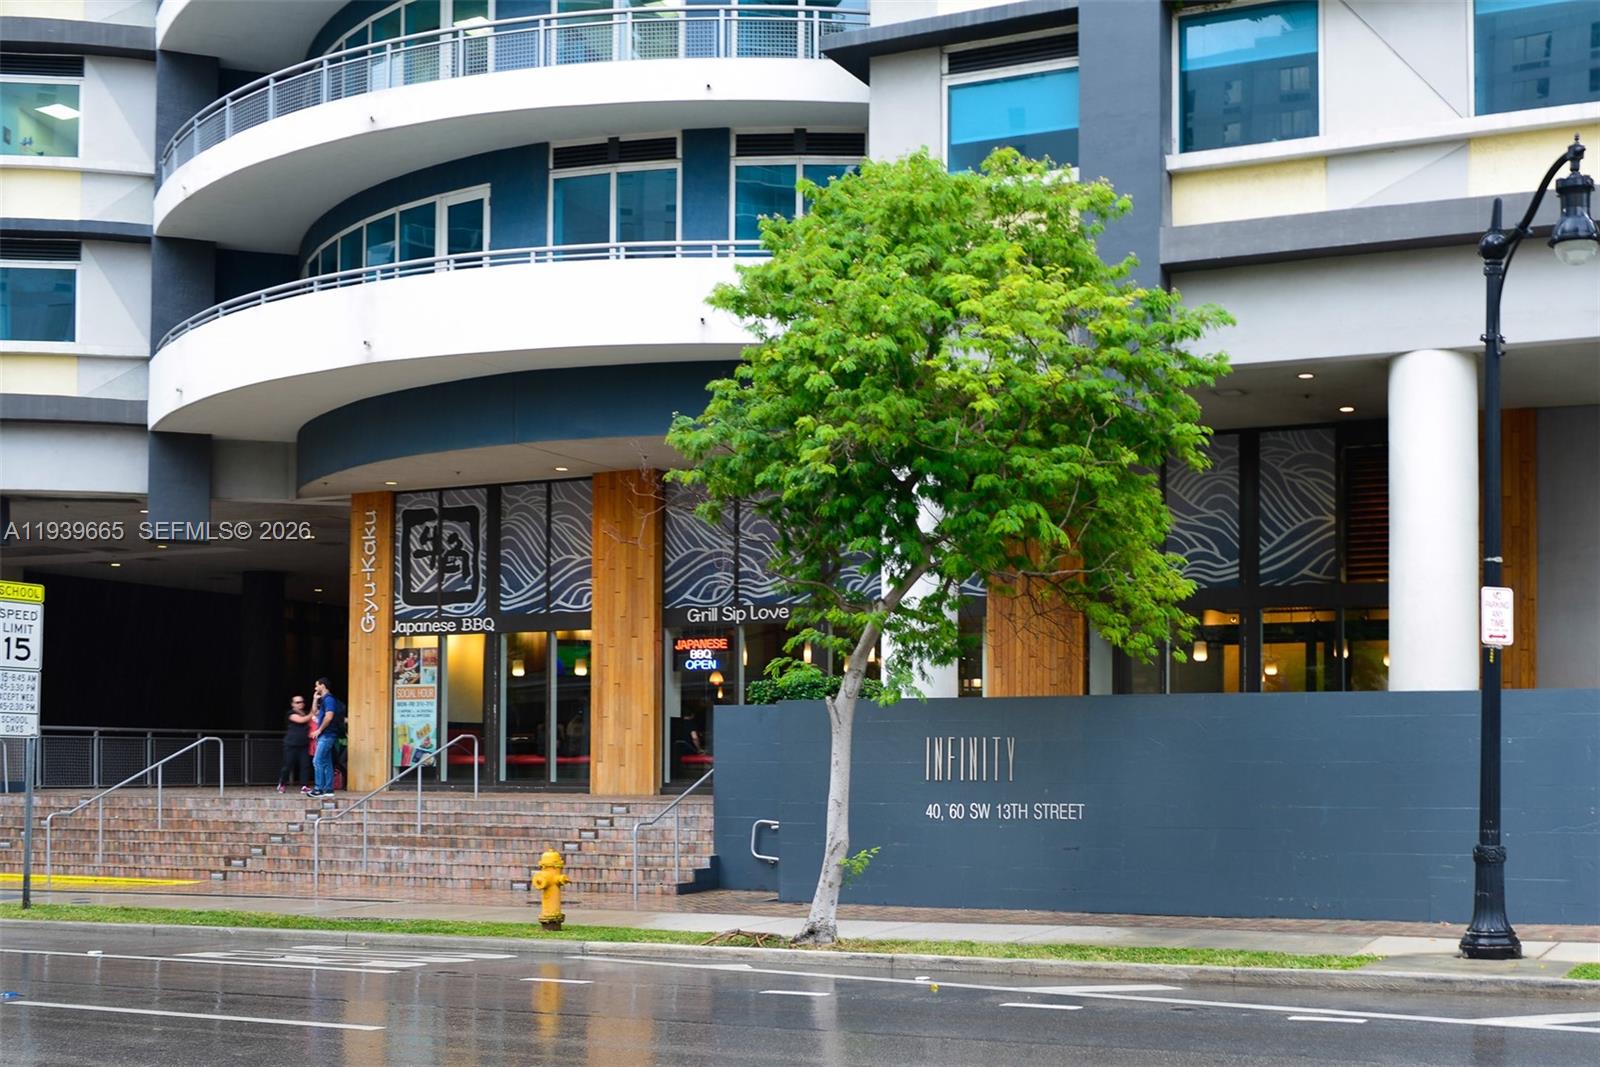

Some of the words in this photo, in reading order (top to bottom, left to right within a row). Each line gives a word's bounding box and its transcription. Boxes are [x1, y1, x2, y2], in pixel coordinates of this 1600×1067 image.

[361, 510, 379, 633] Gyu-Kaku
[0, 584, 41, 600] SCHOOL
[0, 608, 38, 622] SPEED
[687, 607, 718, 623] Grill
[721, 606, 746, 624] Sip
[750, 605, 790, 620] Love
[2, 622, 34, 635] LIMIT
[391, 620, 457, 636] Japanese
[461, 617, 495, 632] BBQ
[4, 636, 31, 661] 15
[674, 638, 729, 650] JAPANESE
[689, 649, 713, 660] BBQ
[684, 659, 717, 670] OPEN
[1, 715, 28, 725] SCHOOL
[5, 725, 24, 734] DAYS
[925, 736, 1015, 782] INFINITY
[925, 803, 944, 821] 40,
[949, 803, 965, 820] 60
[969, 803, 991, 820] SW
[996, 803, 1028, 820] 13TH
[1033, 803, 1085, 820] STREET
